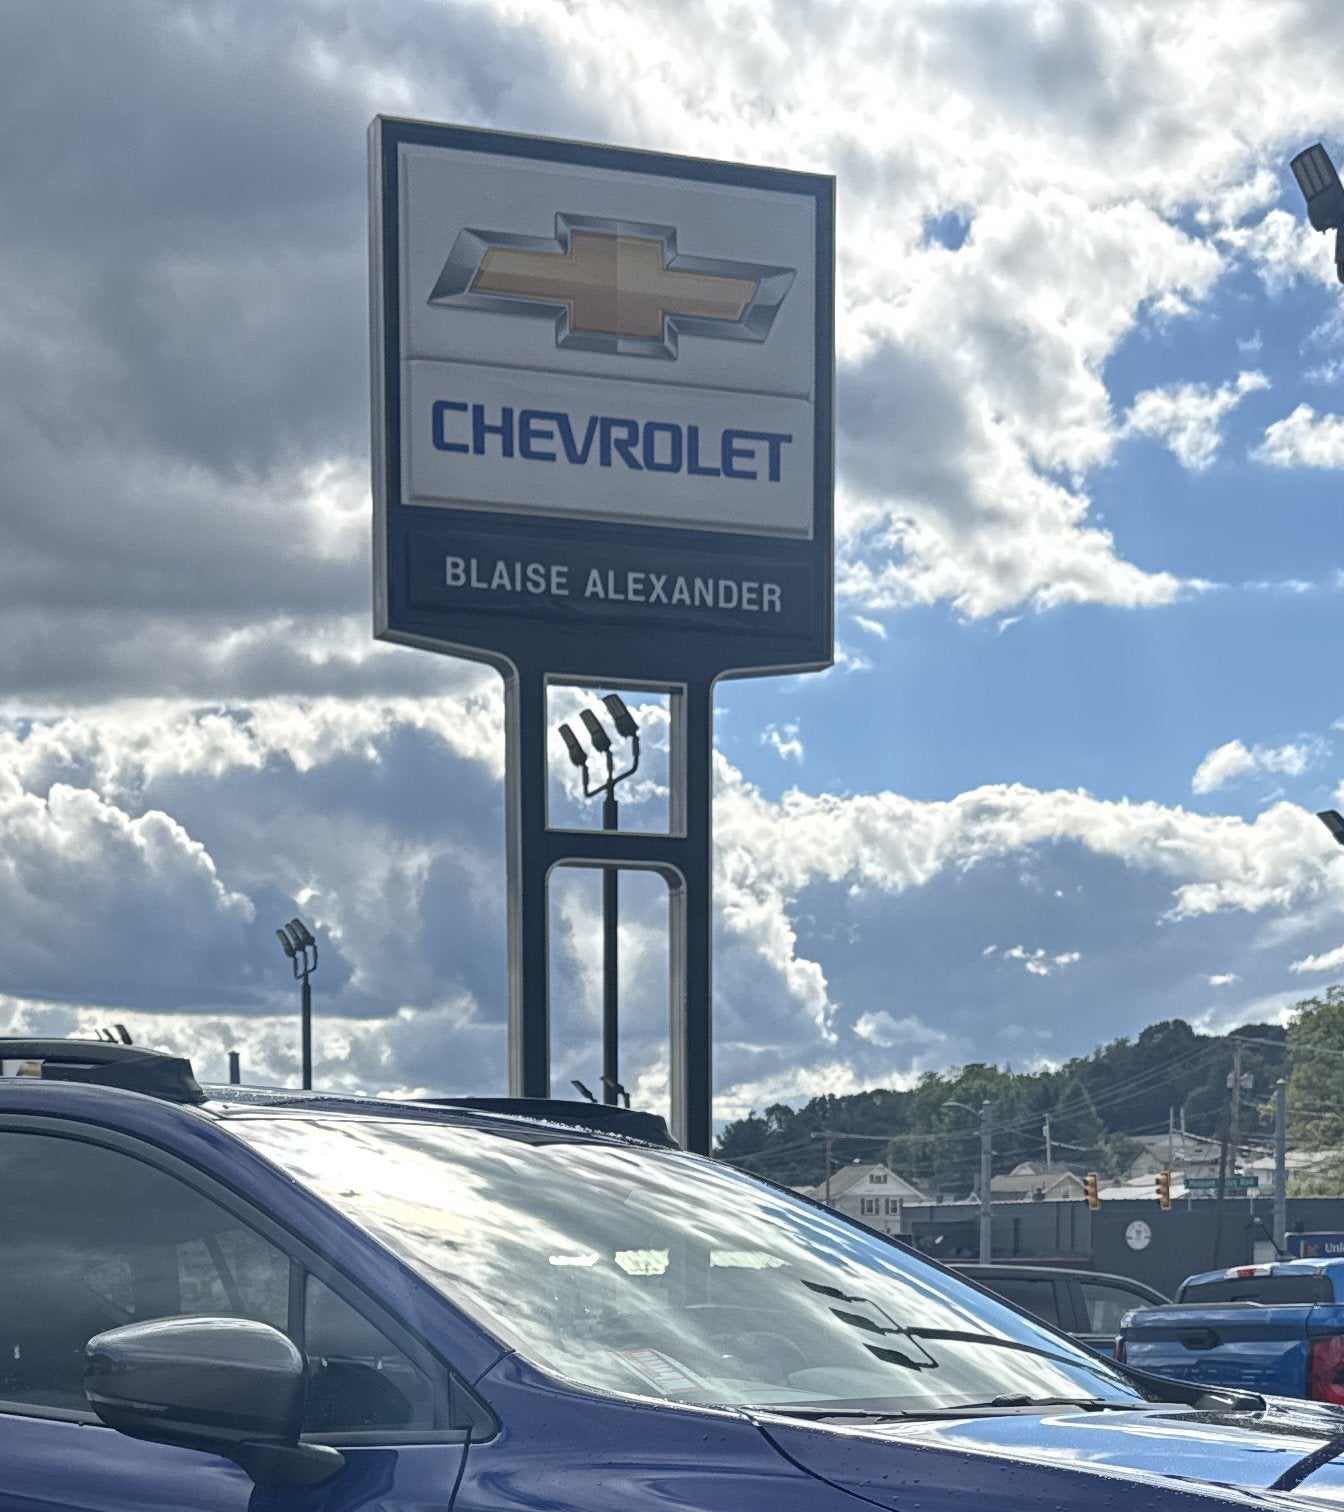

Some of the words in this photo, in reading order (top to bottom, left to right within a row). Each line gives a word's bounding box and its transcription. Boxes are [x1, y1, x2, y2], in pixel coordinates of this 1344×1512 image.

[431, 399, 793, 483] CHEVROLET
[444, 556, 570, 597] BLAISE
[584, 568, 782, 613] ALEXANDER
